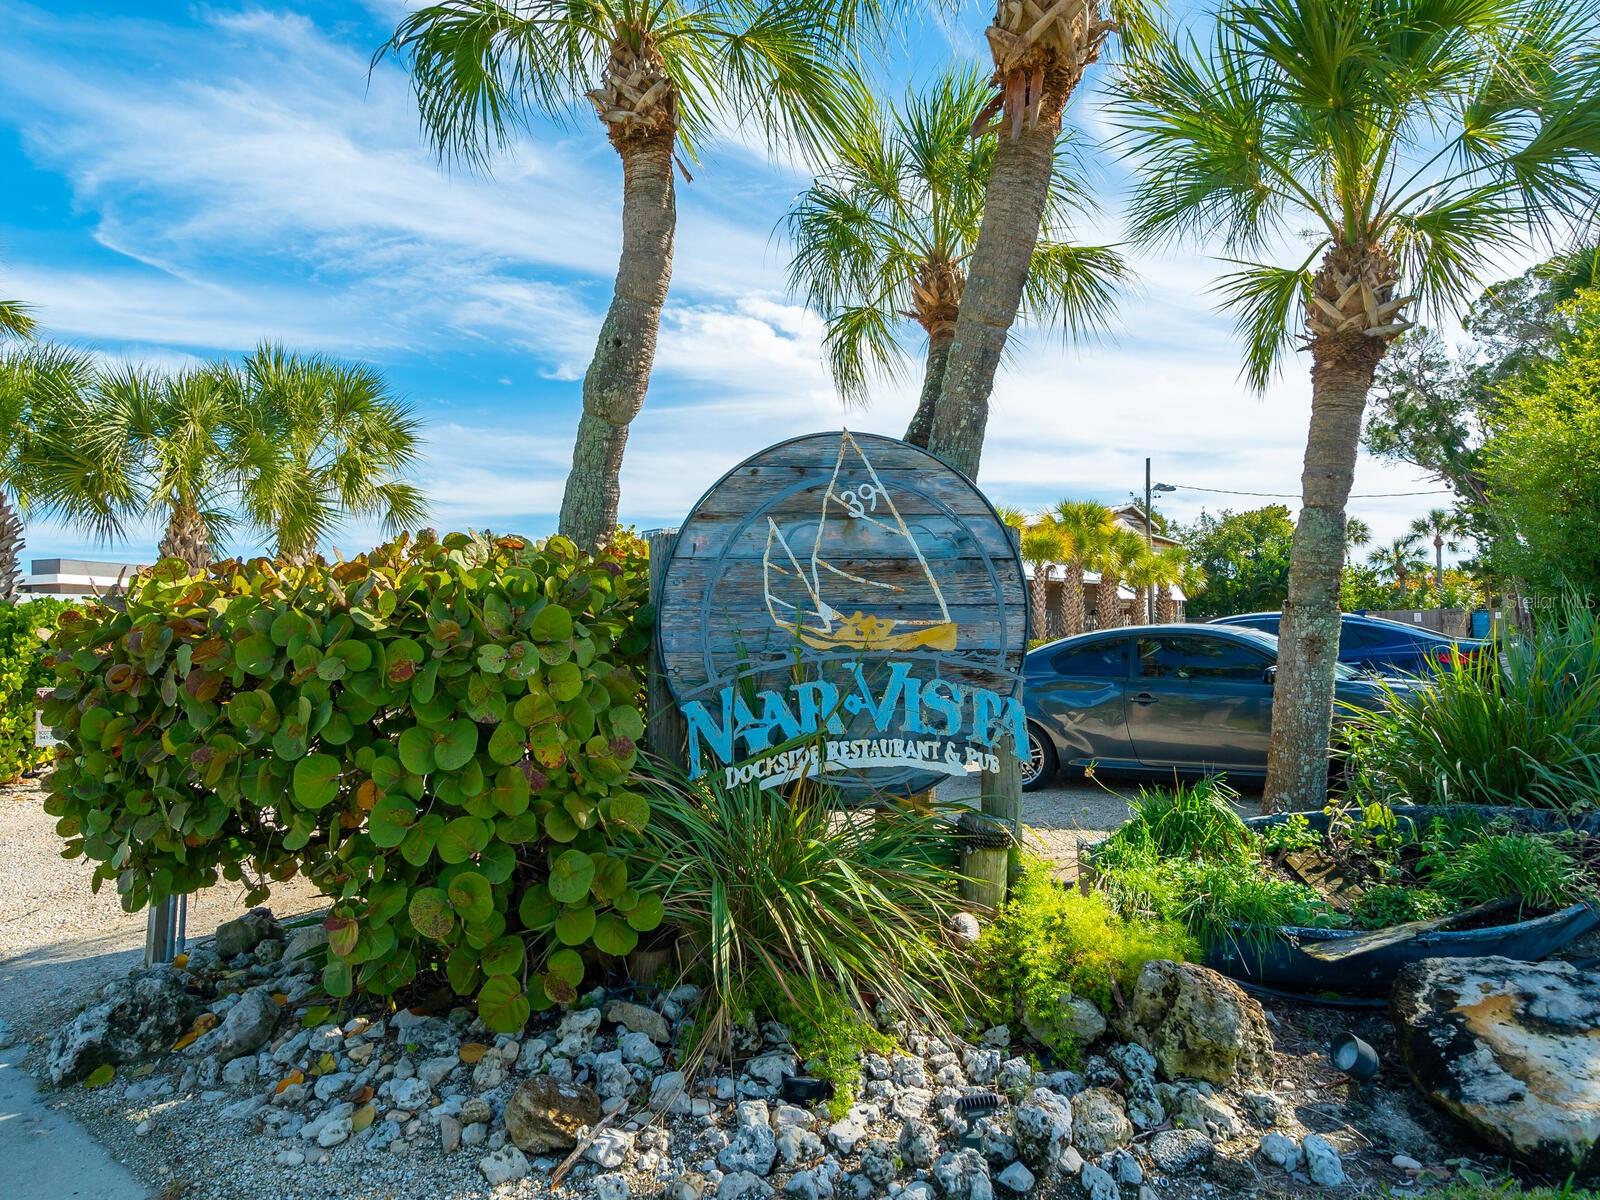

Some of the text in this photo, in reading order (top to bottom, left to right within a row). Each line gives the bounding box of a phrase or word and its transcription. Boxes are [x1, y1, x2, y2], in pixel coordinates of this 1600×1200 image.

[841, 483, 877, 518] 39
[842, 661, 1032, 763] VISTA
[725, 738, 1001, 790] DOCKSIDE RESTAURANT & PUB
